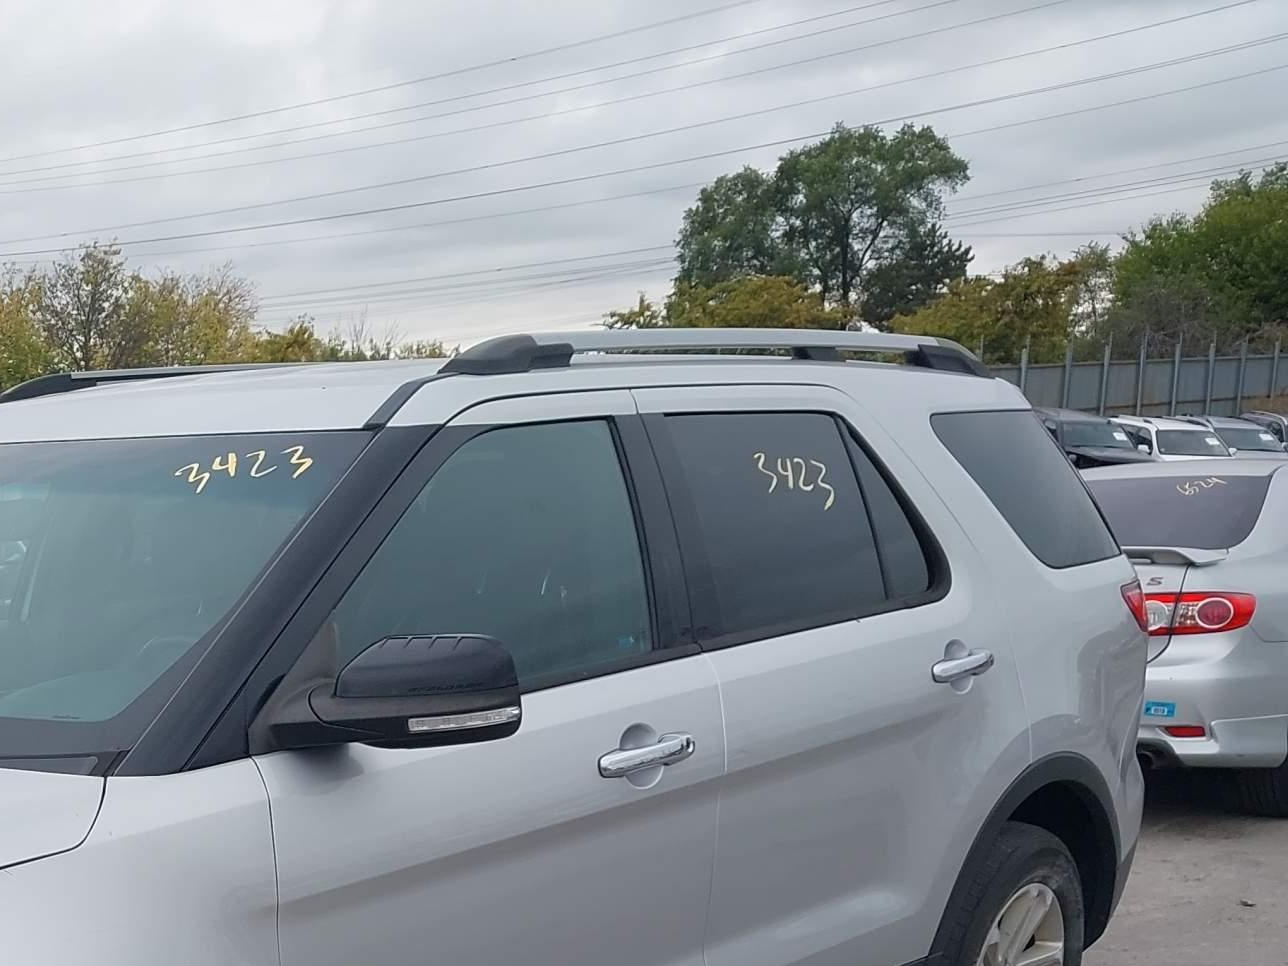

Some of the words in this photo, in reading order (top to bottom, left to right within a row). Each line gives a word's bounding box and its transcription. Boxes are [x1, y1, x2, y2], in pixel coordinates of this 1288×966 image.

[173, 445, 314, 494] 3423
[753, 452, 835, 511] 3423
[1145, 576, 1165, 586] S
